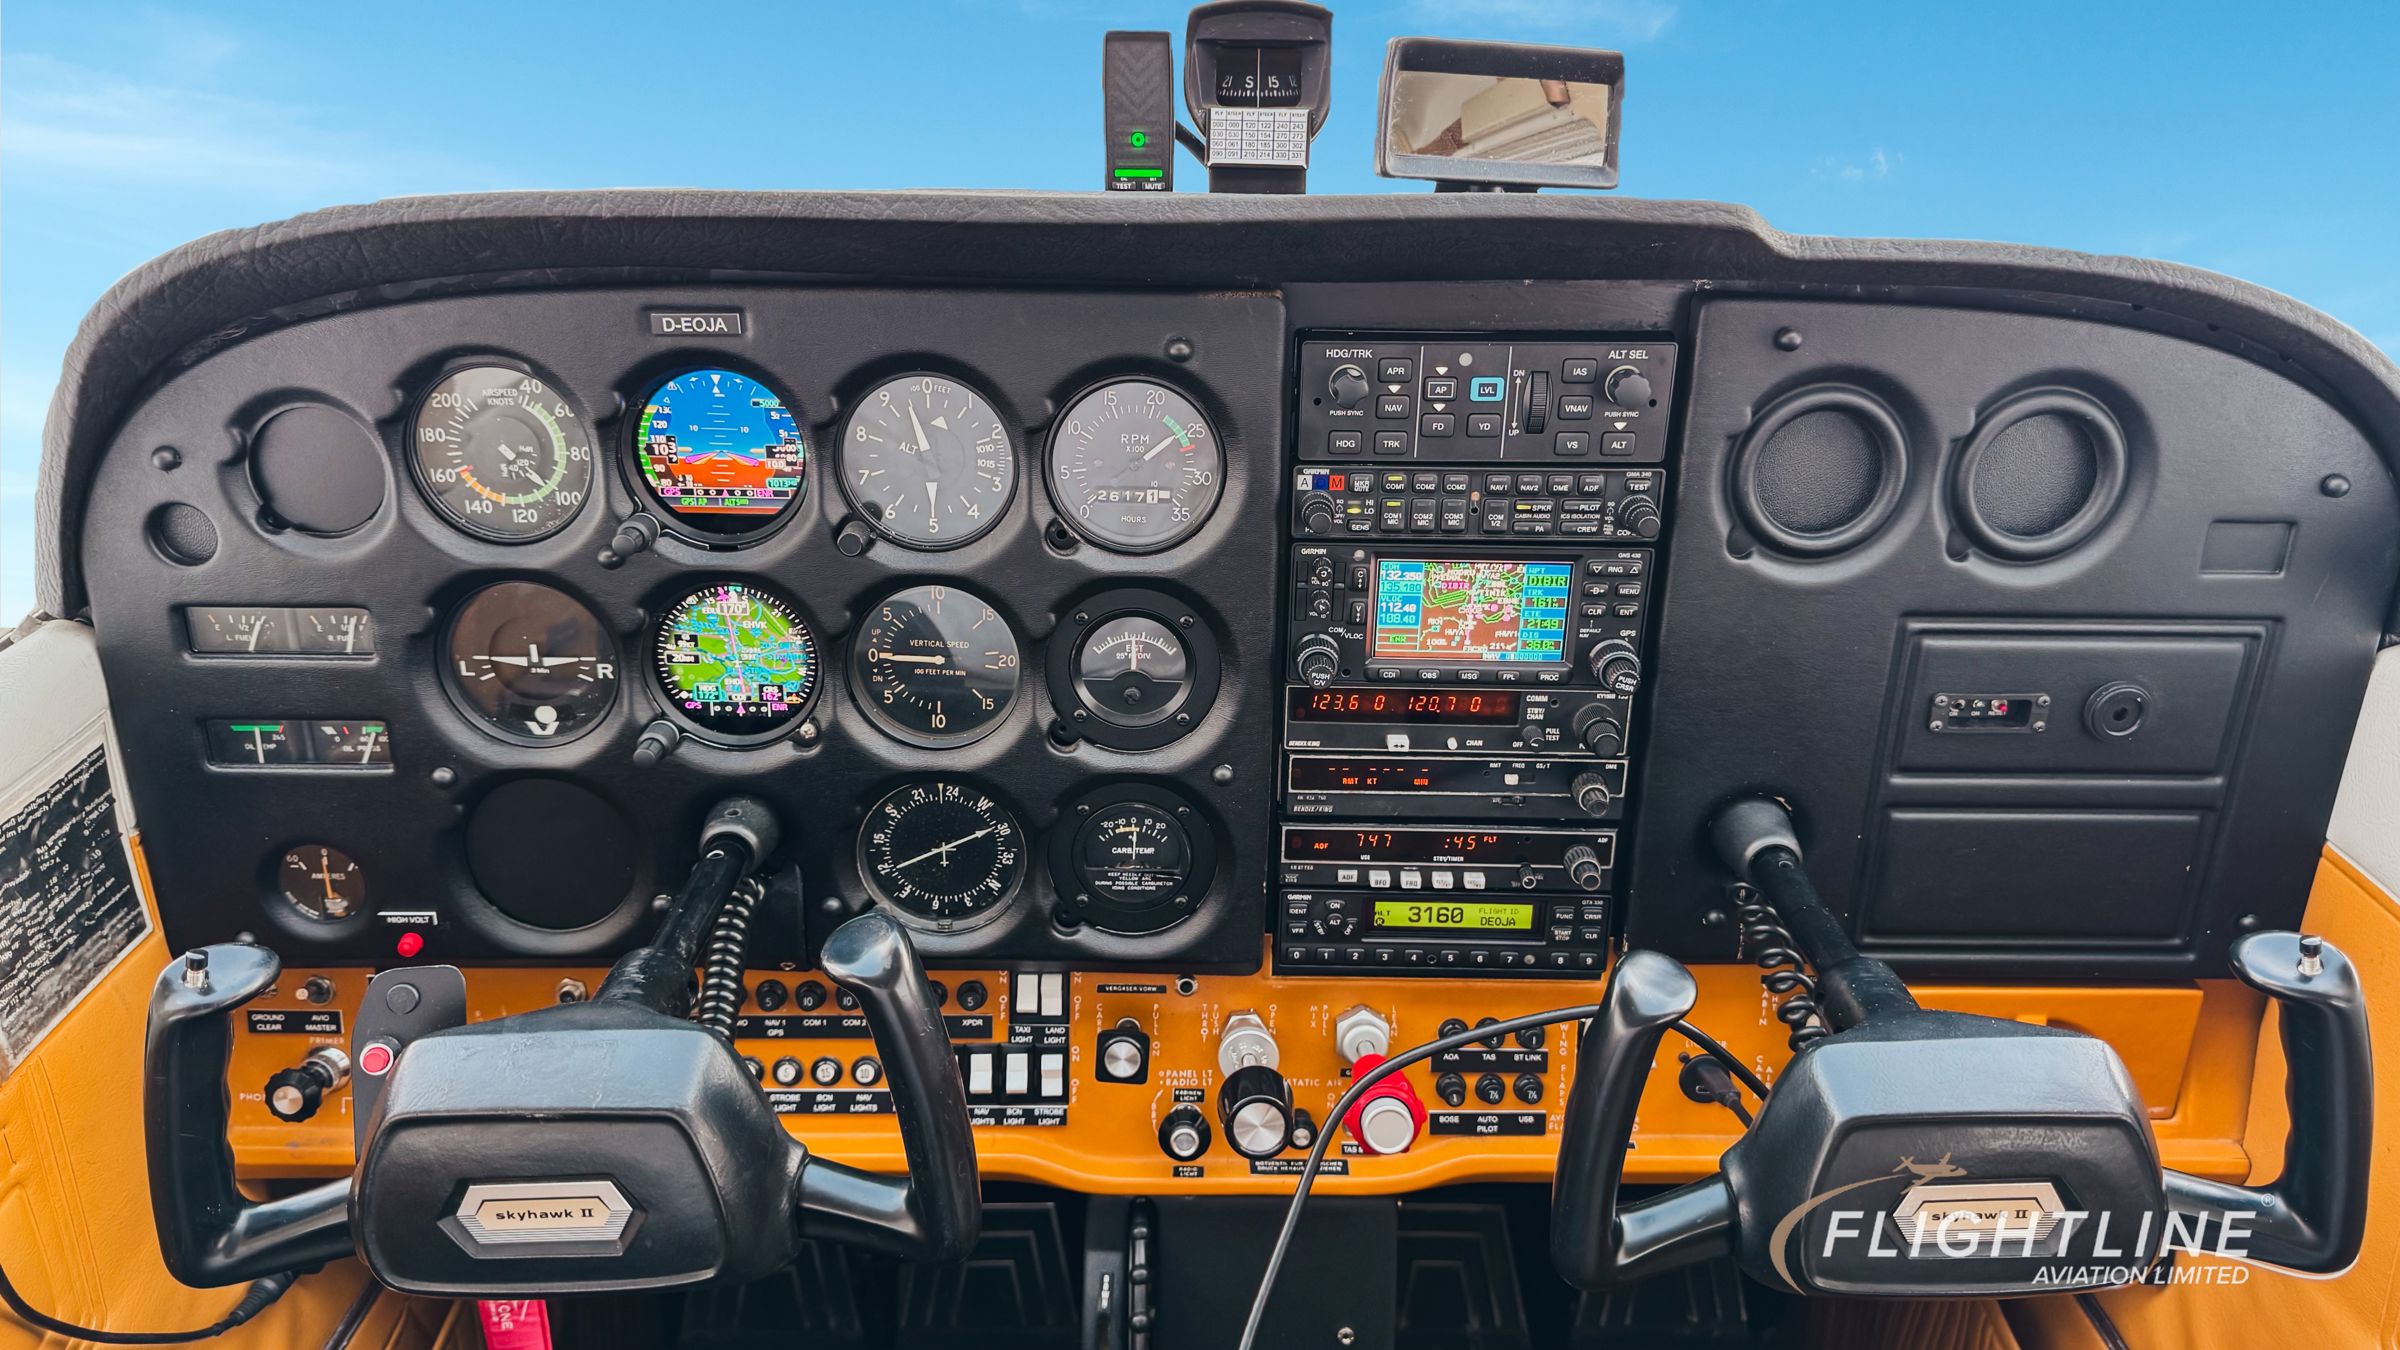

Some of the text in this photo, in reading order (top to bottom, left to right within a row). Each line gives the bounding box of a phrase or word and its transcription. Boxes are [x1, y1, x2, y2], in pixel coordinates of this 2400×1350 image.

[1245, 76, 1254, 88] S
[1268, 76, 1279, 88] 15
[662, 317, 728, 332] D-EOJA
[1326, 349, 1372, 358] HDG/TRK
[1608, 351, 1648, 359] ALT SEL
[1513, 369, 1525, 377] DN
[520, 380, 542, 394] 40
[922, 379, 932, 393] 0
[482, 389, 518, 397] AIRSPEED
[879, 391, 890, 407] 9
[1104, 392, 1117, 406] 15
[1146, 390, 1165, 405] 20
[432, 393, 461, 408] 200
[488, 398, 514, 406] KNOTS
[1385, 404, 1402, 412] NAV
[652, 420, 667, 428] 120
[1068, 421, 1081, 435] 10
[420, 428, 446, 442] 180
[856, 427, 867, 441] 8
[992, 424, 1001, 439] 2
[1188, 424, 1205, 438] 25
[899, 442, 918, 454] ALT
[976, 444, 994, 453] 1010
[1336, 440, 1355, 448] HDG
[1383, 440, 1400, 448] TRK
[570, 448, 589, 461] 80
[977, 459, 995, 468] 1015
[430, 468, 456, 482] 160
[859, 470, 869, 485] 7
[1061, 466, 1070, 479] 5
[1192, 472, 1211, 485] 30
[992, 477, 1002, 492] 3
[556, 492, 581, 506] 100
[756, 489, 773, 497] ENR
[465, 500, 492, 513] 140
[885, 503, 895, 518] 6
[968, 504, 980, 519] 4
[1080, 505, 1089, 518] 0
[512, 509, 538, 523] 120
[1171, 508, 1190, 521] 35
[929, 518, 938, 533] 5
[1529, 577, 1566, 585] DIBIR
[931, 587, 945, 599] 10
[882, 608, 892, 621] 5
[982, 608, 994, 620] 15
[868, 649, 878, 662] 0
[998, 655, 1015, 667] 20
[459, 661, 475, 676] L
[597, 664, 614, 679] R
[884, 690, 893, 703] 5
[982, 698, 994, 710] 15
[932, 715, 946, 728] 10
[387, 916, 429, 924] HIGH VOLT
[1408, 907, 1463, 924] 3160
[1480, 917, 1516, 926] DEOJA
[252, 1014, 285, 1022] GROUND
[496, 1208, 594, 1221] skyhawk II
